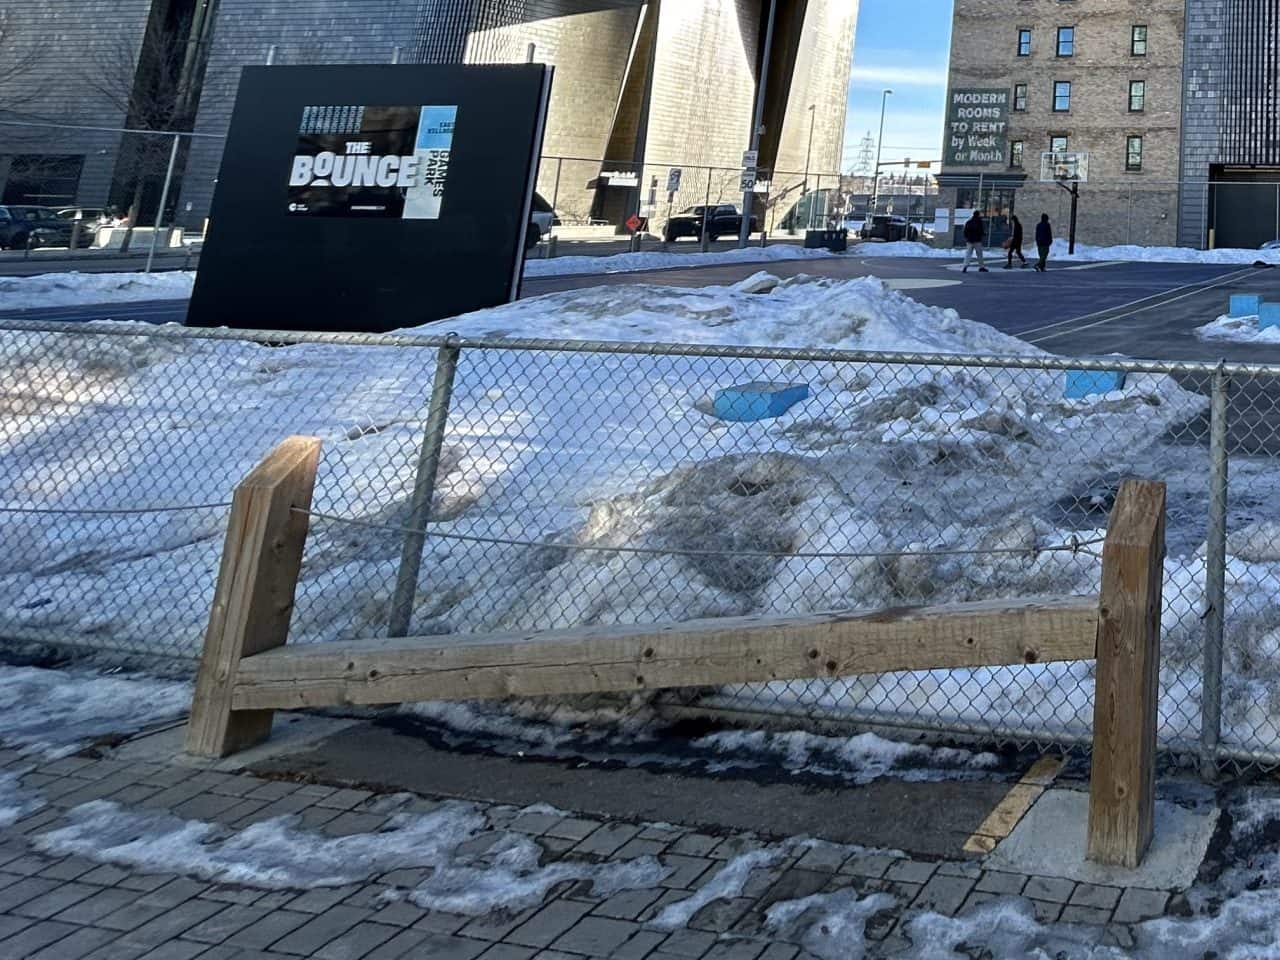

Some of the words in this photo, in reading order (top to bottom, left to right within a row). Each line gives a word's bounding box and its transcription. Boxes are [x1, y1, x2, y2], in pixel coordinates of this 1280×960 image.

[953, 93, 1006, 104] MODERN
[957, 107, 1001, 119] ROOMS
[951, 122, 969, 132] TO
[972, 122, 1006, 132] RENT
[951, 135, 965, 149] by
[968, 134, 997, 147] Week
[345, 142, 372, 154] THE
[954, 152, 966, 161] or
[969, 150, 1002, 161] Month
[289, 151, 417, 188] BOUNCE
[424, 150, 439, 185] PARK
[433, 150, 449, 197] GAMES
[741, 179, 753, 189] 50
